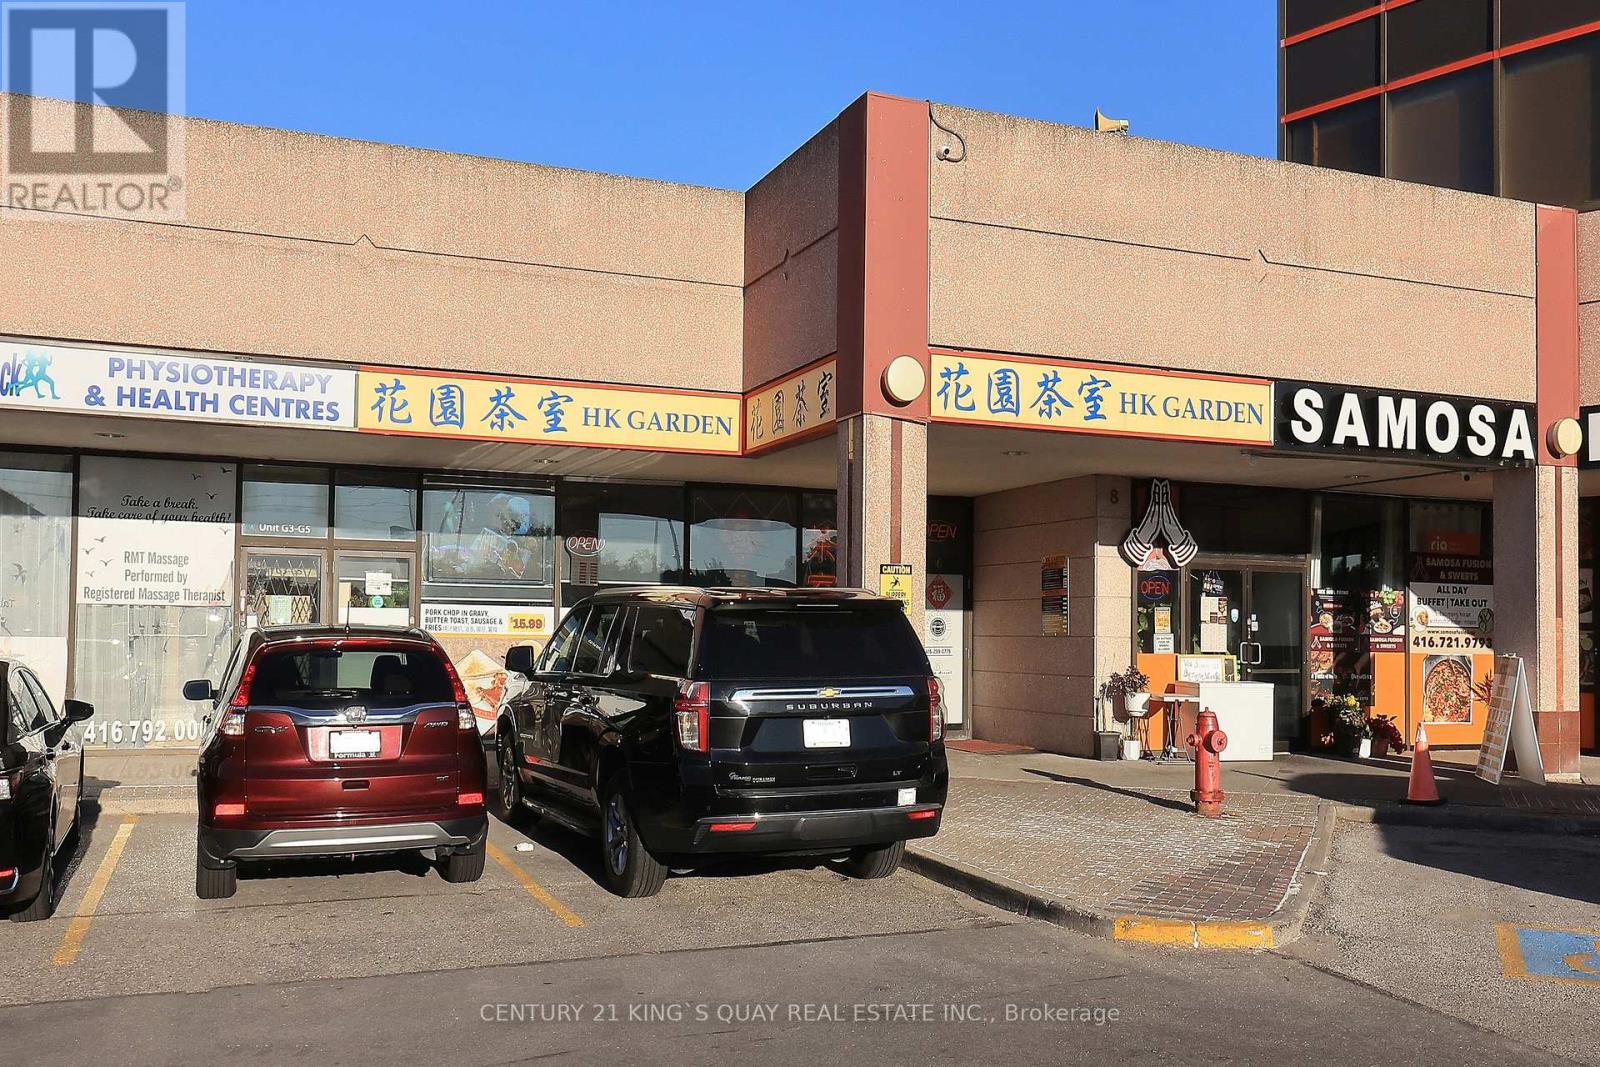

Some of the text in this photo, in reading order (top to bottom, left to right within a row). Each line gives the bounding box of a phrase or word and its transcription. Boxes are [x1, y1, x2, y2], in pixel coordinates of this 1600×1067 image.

[108, 356, 332, 394] PHYSIOTHERAPY
[936, 363, 1264, 426] 花園茶室 HK GARDEN
[84, 384, 340, 422] & HEALTH CENTRES
[369, 378, 733, 437] 花園茶室 HK GARDEN
[750, 371, 833, 442] 花園茶室
[1290, 387, 1535, 460] SAMOSA
[121, 495, 199, 510] Take a break.
[1110, 489, 1119, 504] 8
[87, 506, 232, 525] Take care of your health!
[259, 523, 311, 534] Unit G3-G5
[568, 536, 602, 551] OPEN
[124, 551, 189, 567] RMT Massage
[1425, 557, 1492, 569] SAMOSA FUSION
[124, 569, 188, 585] Performed by
[882, 566, 911, 575] CAUTION
[1448, 572, 1479, 581] SWEETS
[83, 586, 226, 605] Registered Massage Therapist
[1141, 580, 1170, 596] OPEN
[1437, 585, 1468, 595] ALL DAY
[1417, 597, 1488, 608] BUFFET TAKE OUT
[425, 608, 442, 616] PORK
[443, 609, 460, 617] CHOP
[425, 616, 449, 625] BUTTER
[471, 618, 497, 626] SAUSAGE
[425, 624, 442, 633] FRIES
[1413, 636, 1492, 649] 416.721.9793
[786, 701, 873, 710] SUBURBAN
